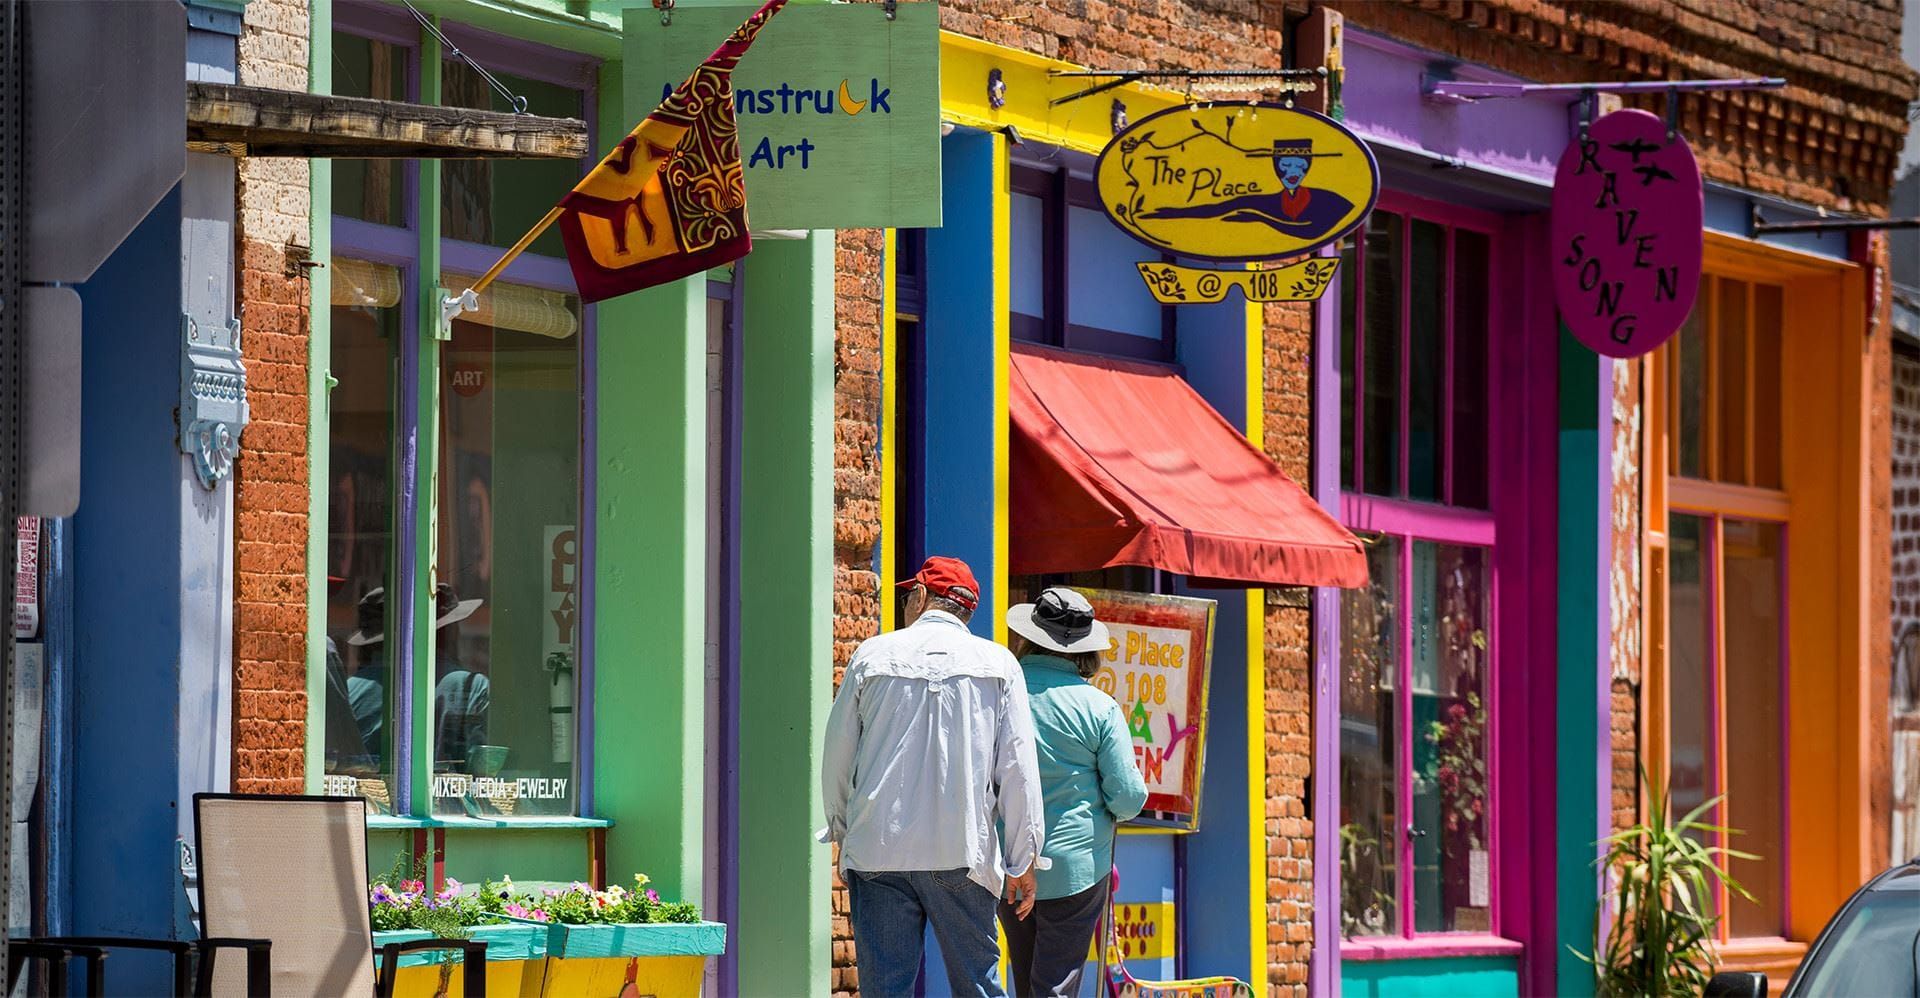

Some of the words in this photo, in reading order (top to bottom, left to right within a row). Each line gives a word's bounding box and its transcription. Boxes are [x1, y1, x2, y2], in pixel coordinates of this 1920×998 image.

[748, 136, 815, 170] Art
[1144, 155, 1186, 187] The
[1187, 167, 1263, 203] Place
[1575, 141, 1679, 302] RAVEN
[1196, 273, 1222, 299] @
[1249, 272, 1279, 300] 108
[1564, 233, 1638, 346] SONG
[452, 371, 483, 387] ART
[1125, 629, 1185, 669] Place
[1125, 671, 1167, 705] 108
[431, 776, 467, 798] MIXED
[512, 778, 568, 800] JEWELRY
